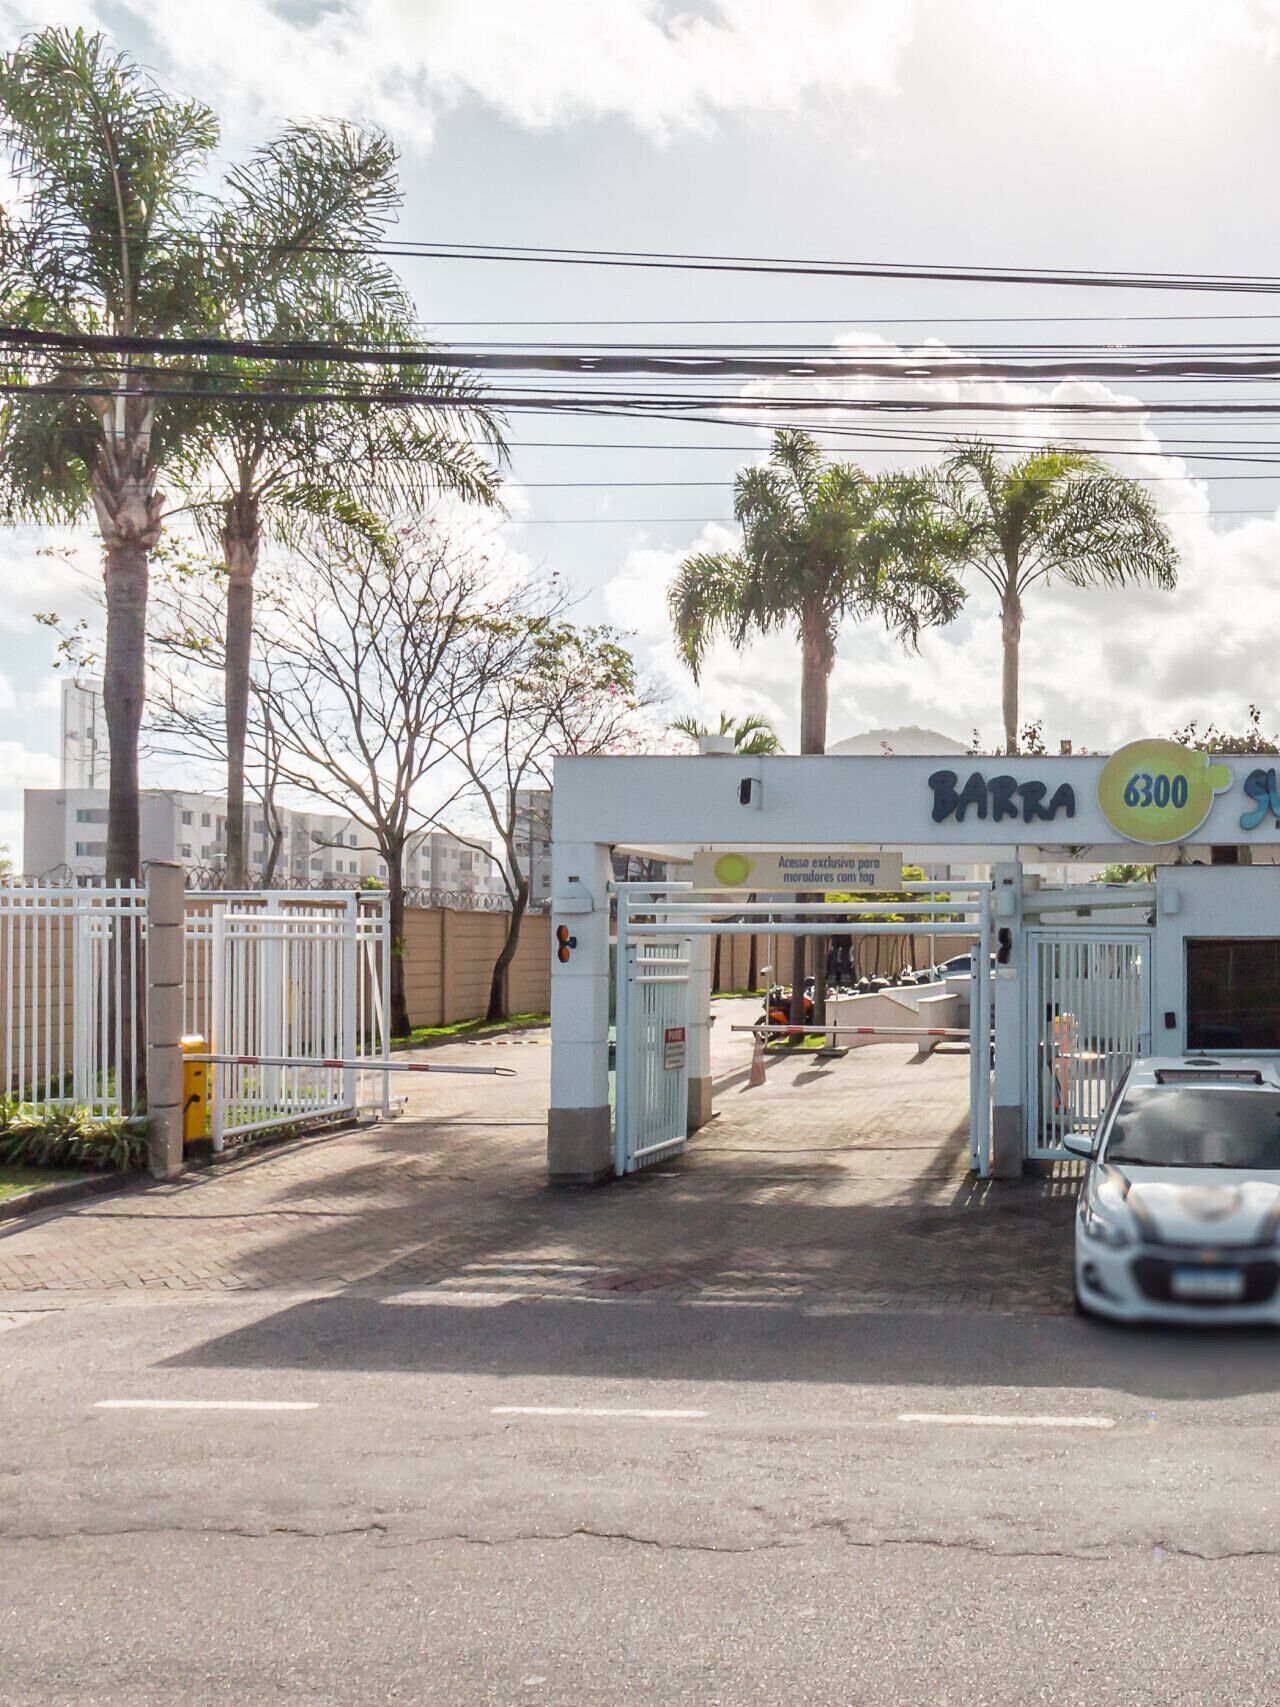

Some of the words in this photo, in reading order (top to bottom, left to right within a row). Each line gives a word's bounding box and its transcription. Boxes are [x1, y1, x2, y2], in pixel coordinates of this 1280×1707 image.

[928, 770, 1076, 823] BARRA
[1124, 773, 1188, 809] 6300
[778, 855, 809, 868] Acesso
[812, 856, 855, 868] exclusivo
[858, 859, 880, 871] para
[783, 869, 834, 882] moradores
[837, 873, 856, 882] com
[859, 871, 875, 885] tag
